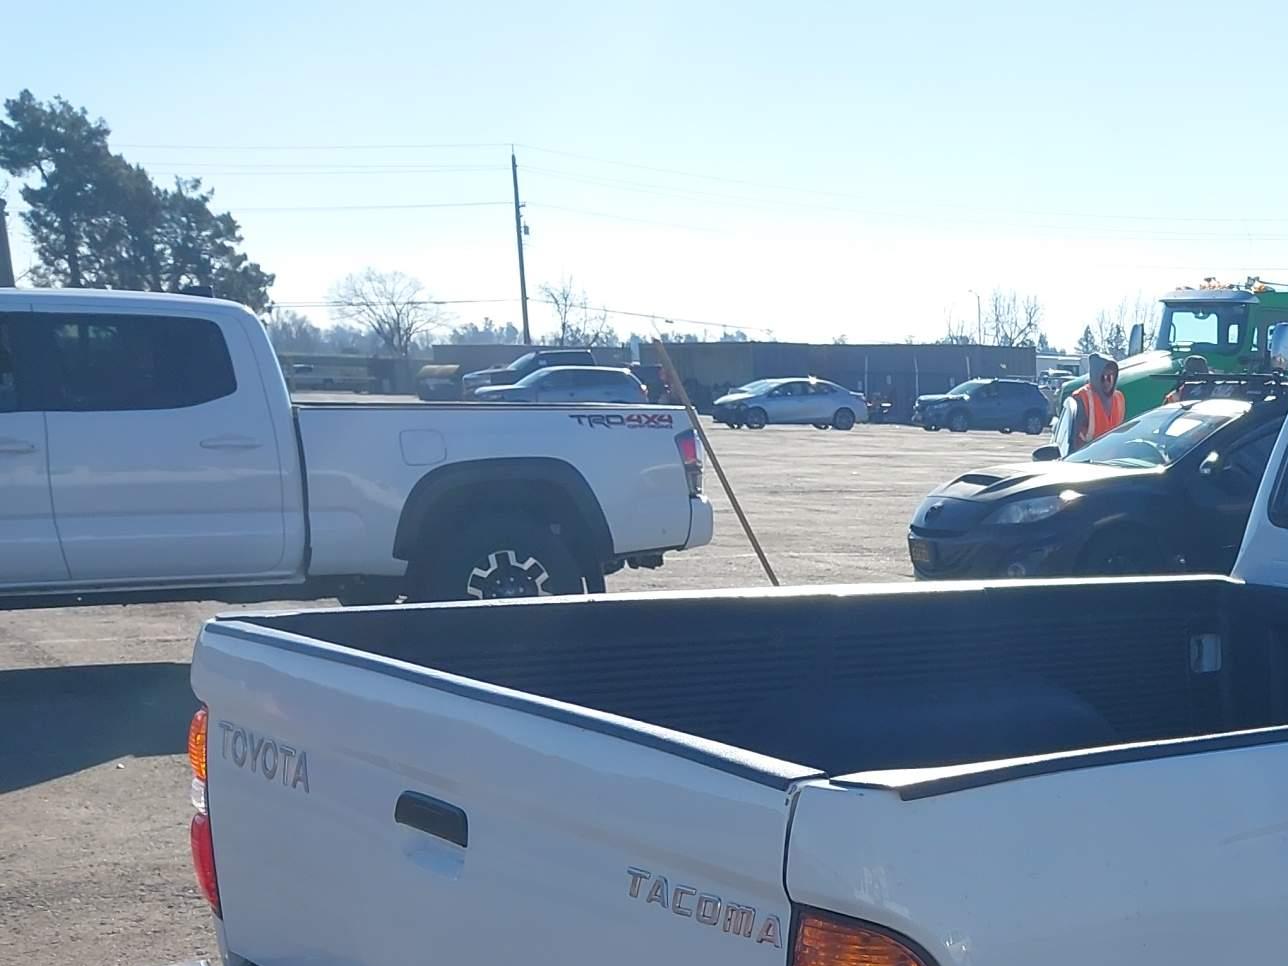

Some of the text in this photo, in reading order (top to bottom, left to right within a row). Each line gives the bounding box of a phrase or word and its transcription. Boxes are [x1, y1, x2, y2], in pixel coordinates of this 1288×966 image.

[568, 414, 625, 429] TRD
[218, 719, 310, 795] TOYOTA
[626, 865, 783, 949] TACOMA
